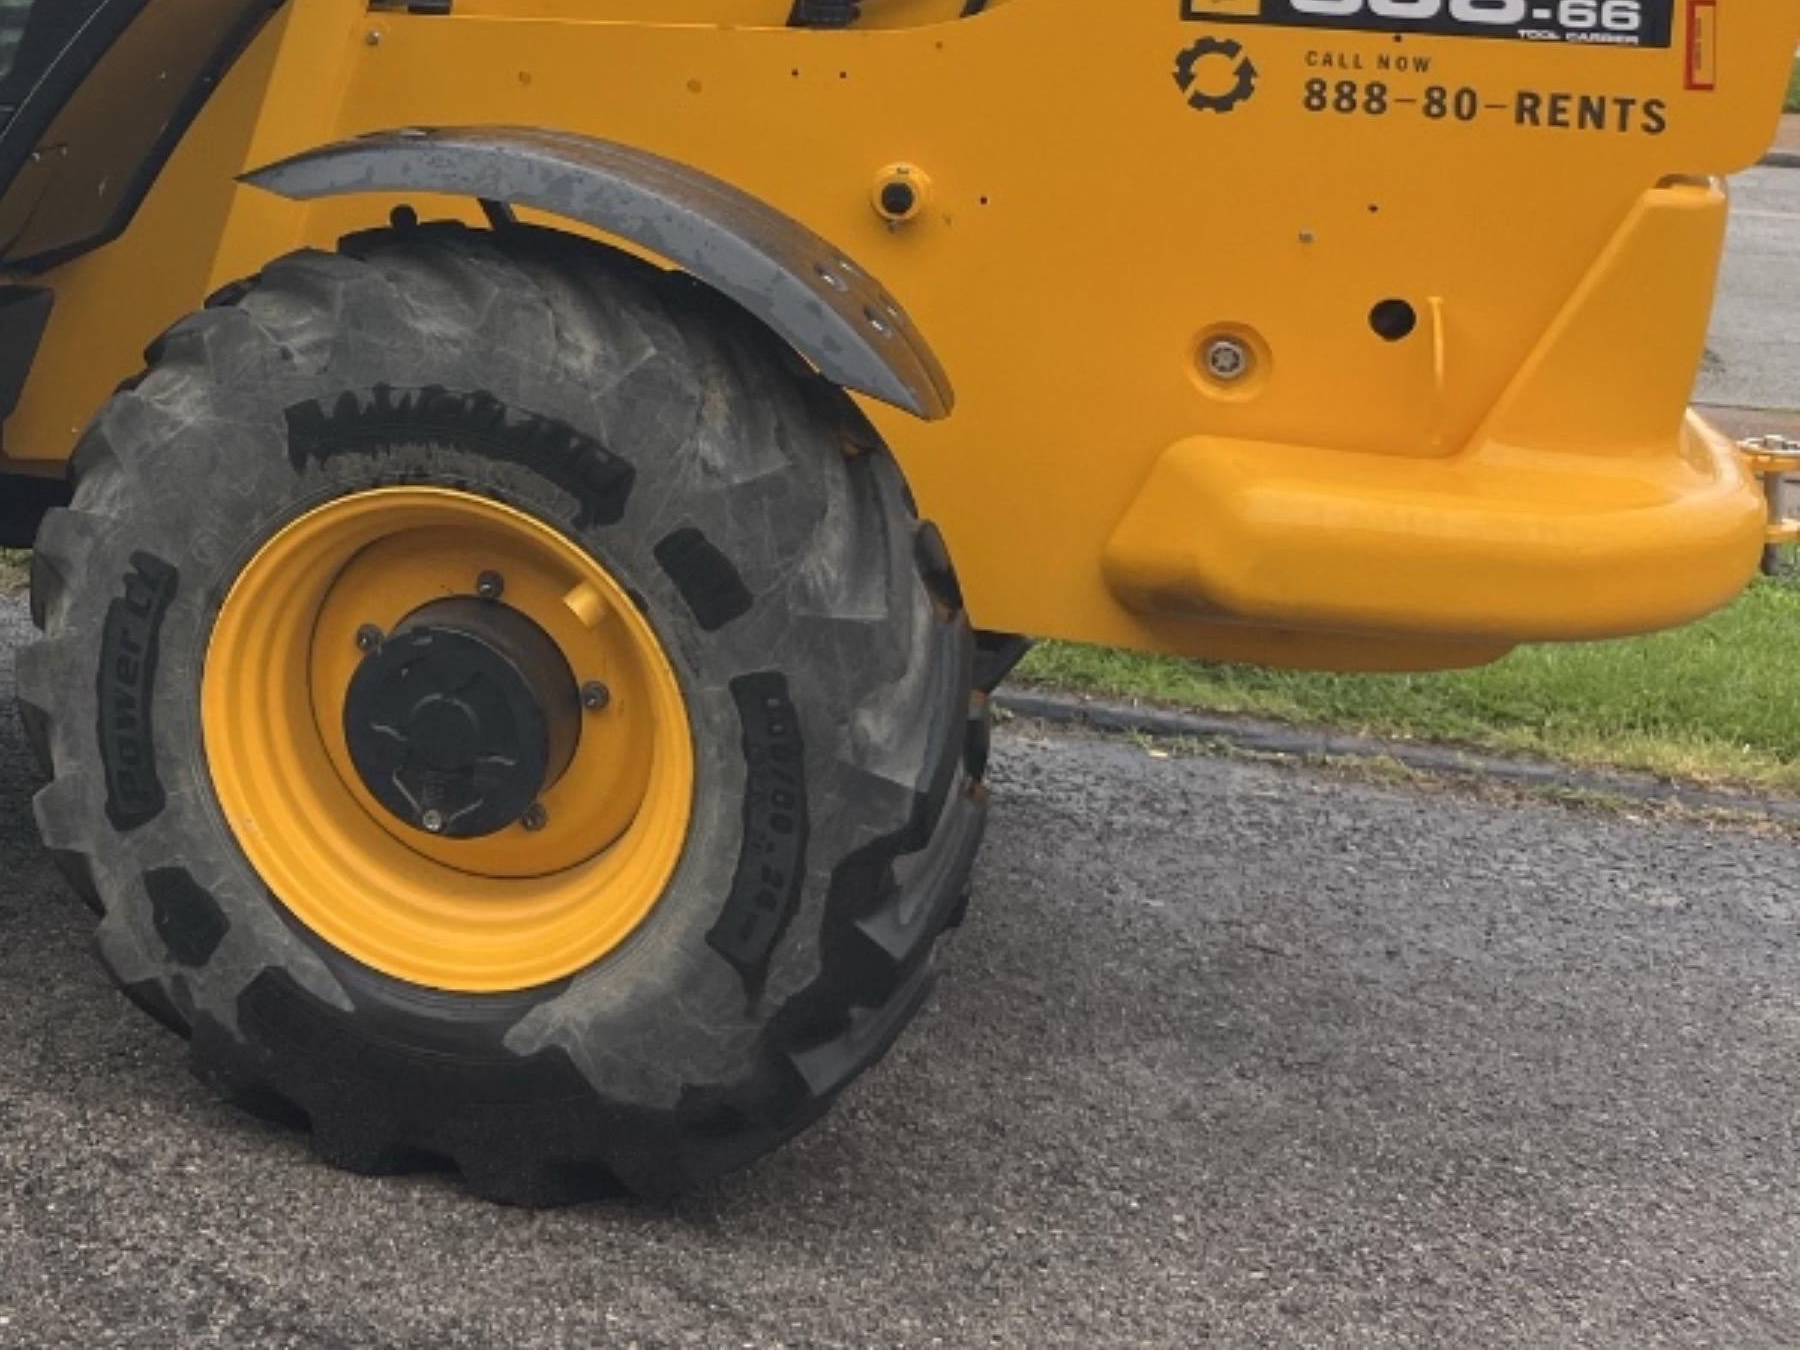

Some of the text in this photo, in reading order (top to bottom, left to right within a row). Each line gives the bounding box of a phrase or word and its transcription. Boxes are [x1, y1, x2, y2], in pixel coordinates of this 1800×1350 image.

[1305, 51, 1431, 73] CALL NOW
[1303, 78, 1668, 136] 888-80-RENTS
